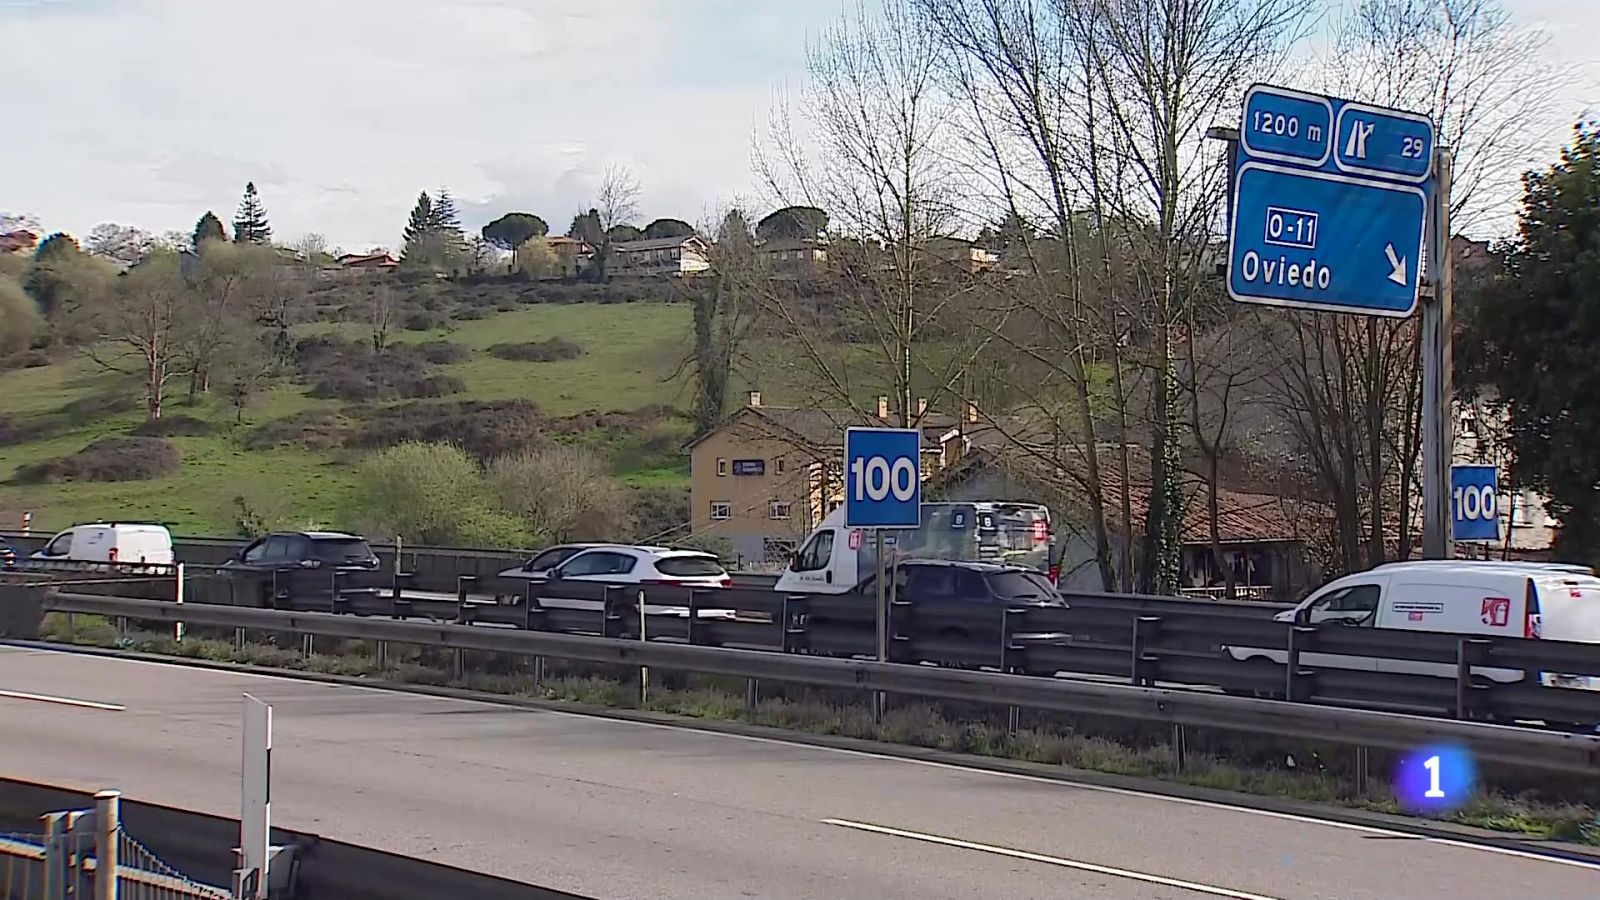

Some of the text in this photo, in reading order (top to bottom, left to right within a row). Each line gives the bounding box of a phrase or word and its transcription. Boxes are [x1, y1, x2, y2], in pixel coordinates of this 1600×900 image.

[1254, 111, 1322, 142] 1200 m
[1401, 137, 1424, 158] 29
[1242, 251, 1330, 290] Oviedo
[851, 456, 917, 502] 100
[1454, 485, 1496, 521] 100
